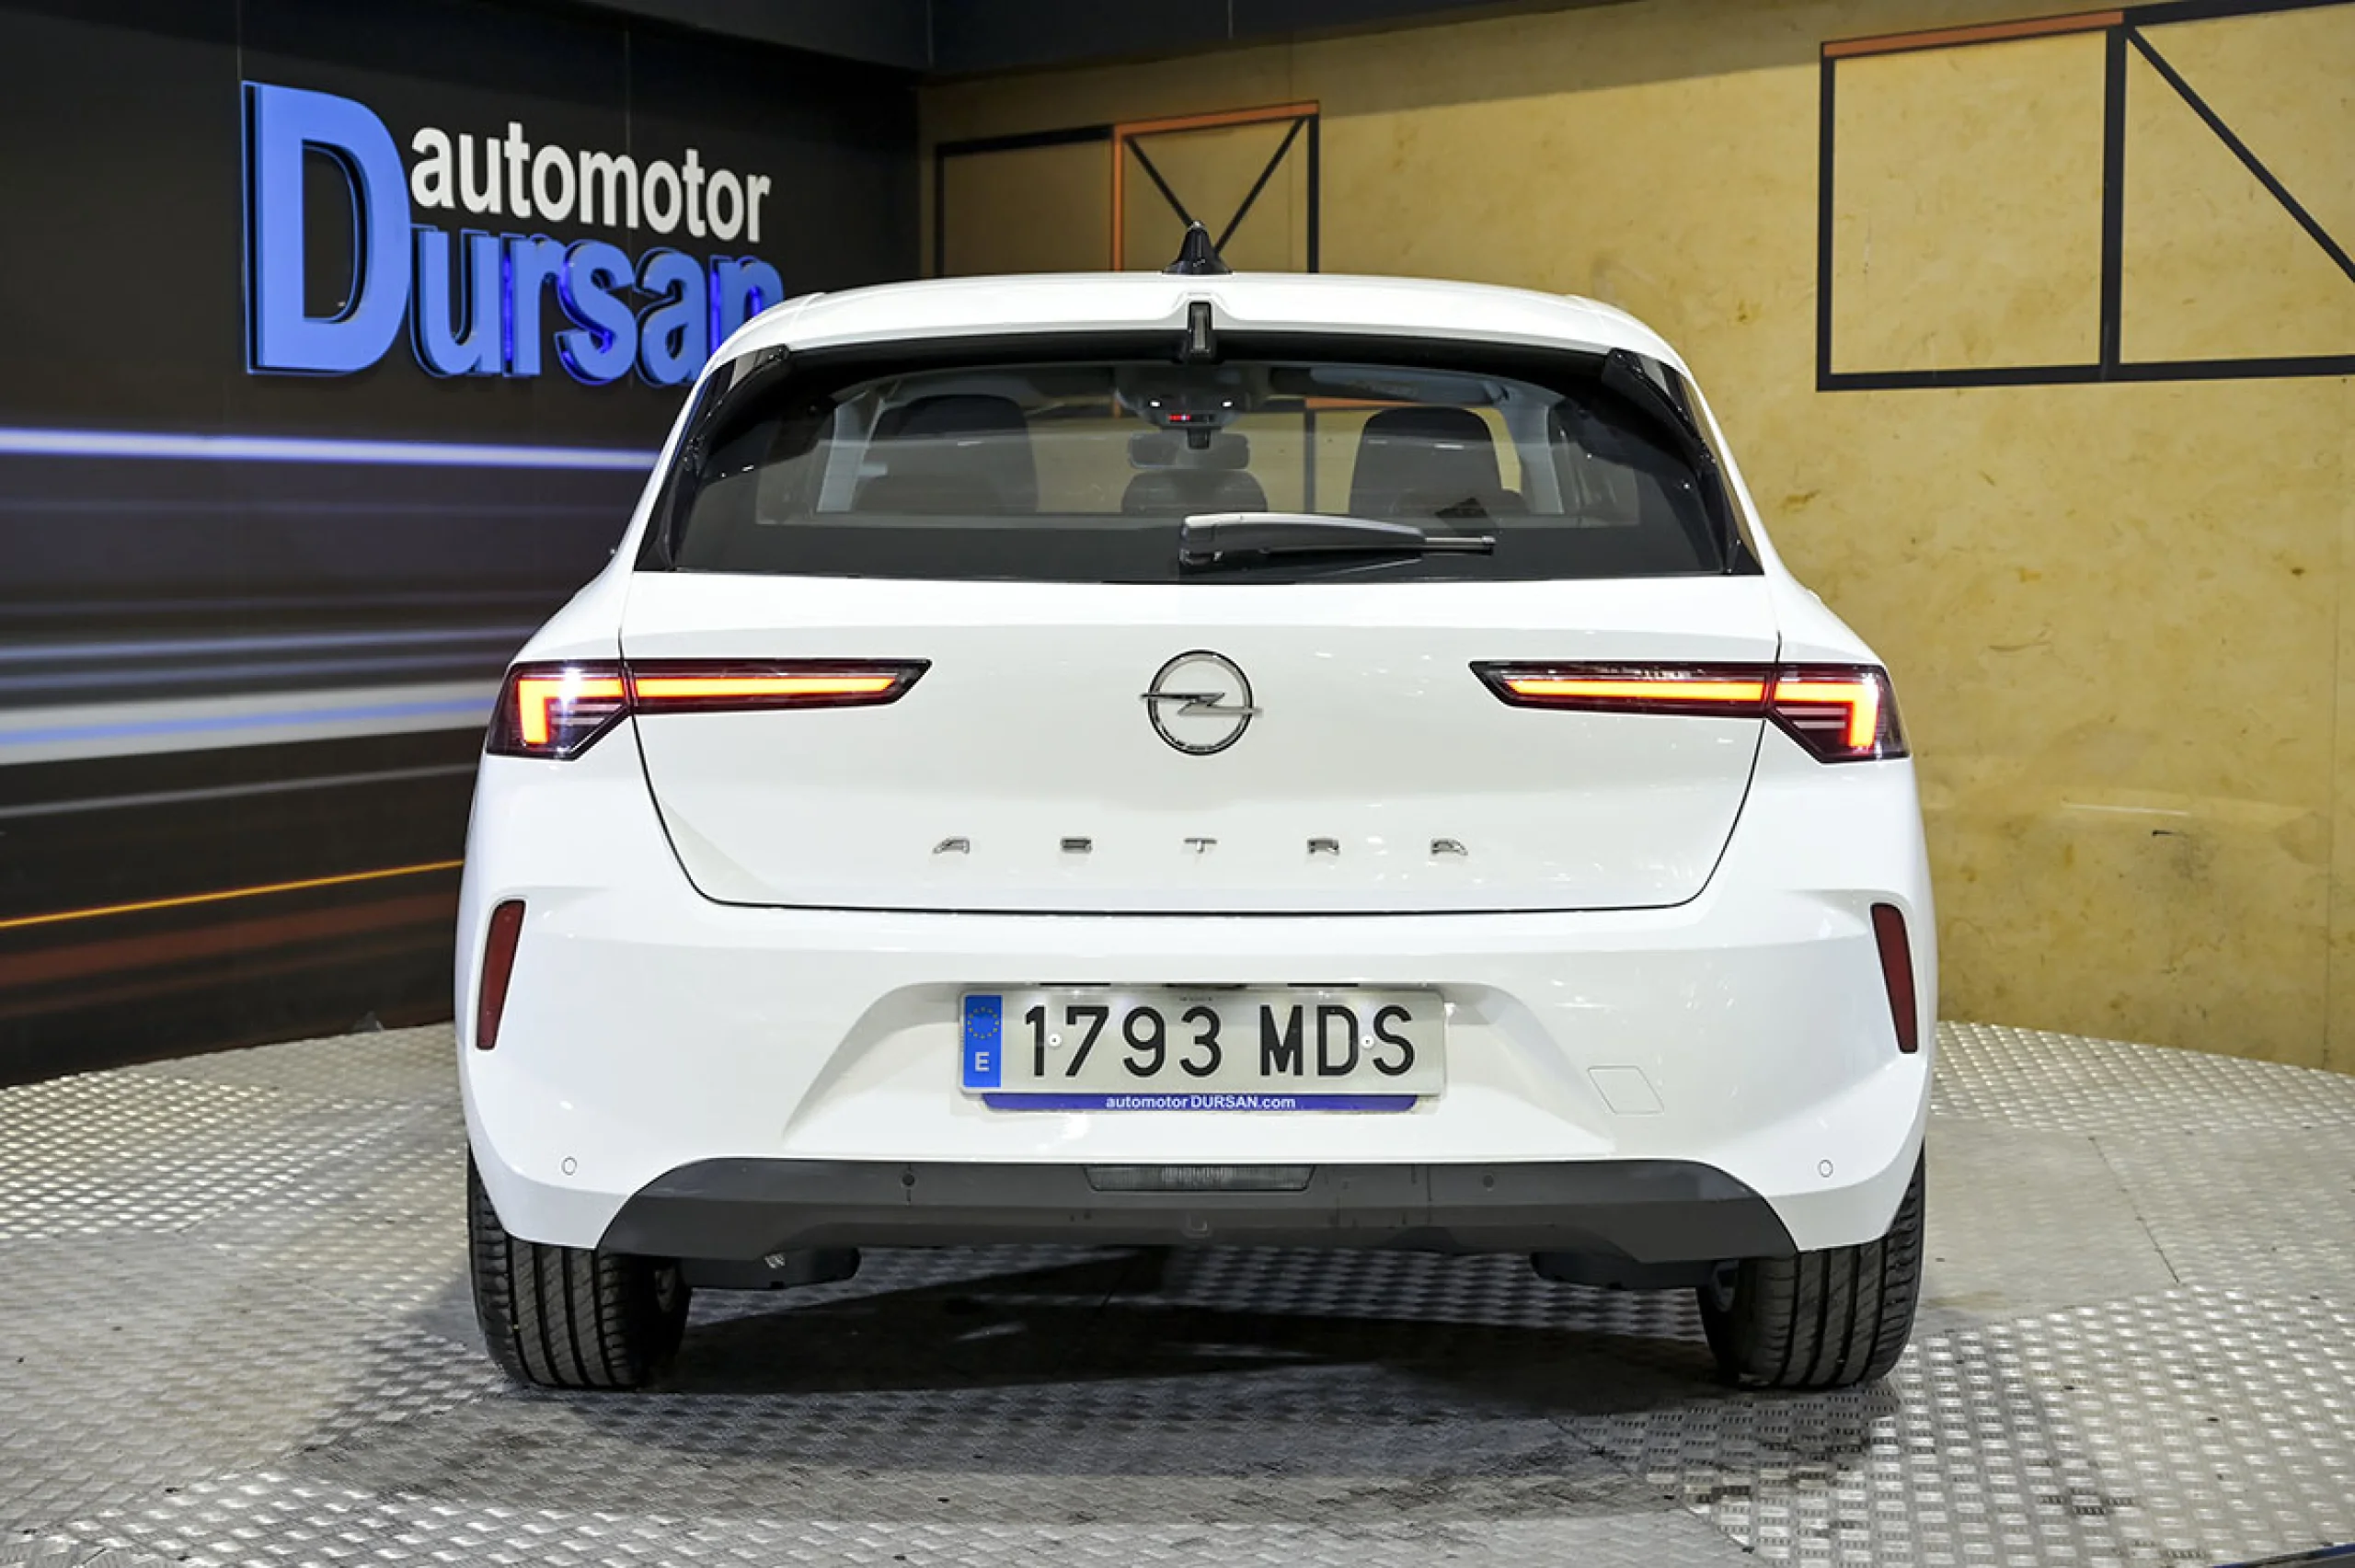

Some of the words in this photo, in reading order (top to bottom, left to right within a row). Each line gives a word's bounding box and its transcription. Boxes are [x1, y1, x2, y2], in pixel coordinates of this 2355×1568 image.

[410, 121, 771, 243] automotor
[241, 80, 784, 385] Dursan
[932, 837, 1468, 855] ASTRA
[975, 1051, 990, 1071] E
[1025, 1005, 1222, 1077] 1793
[1259, 1005, 1415, 1077] MDS
